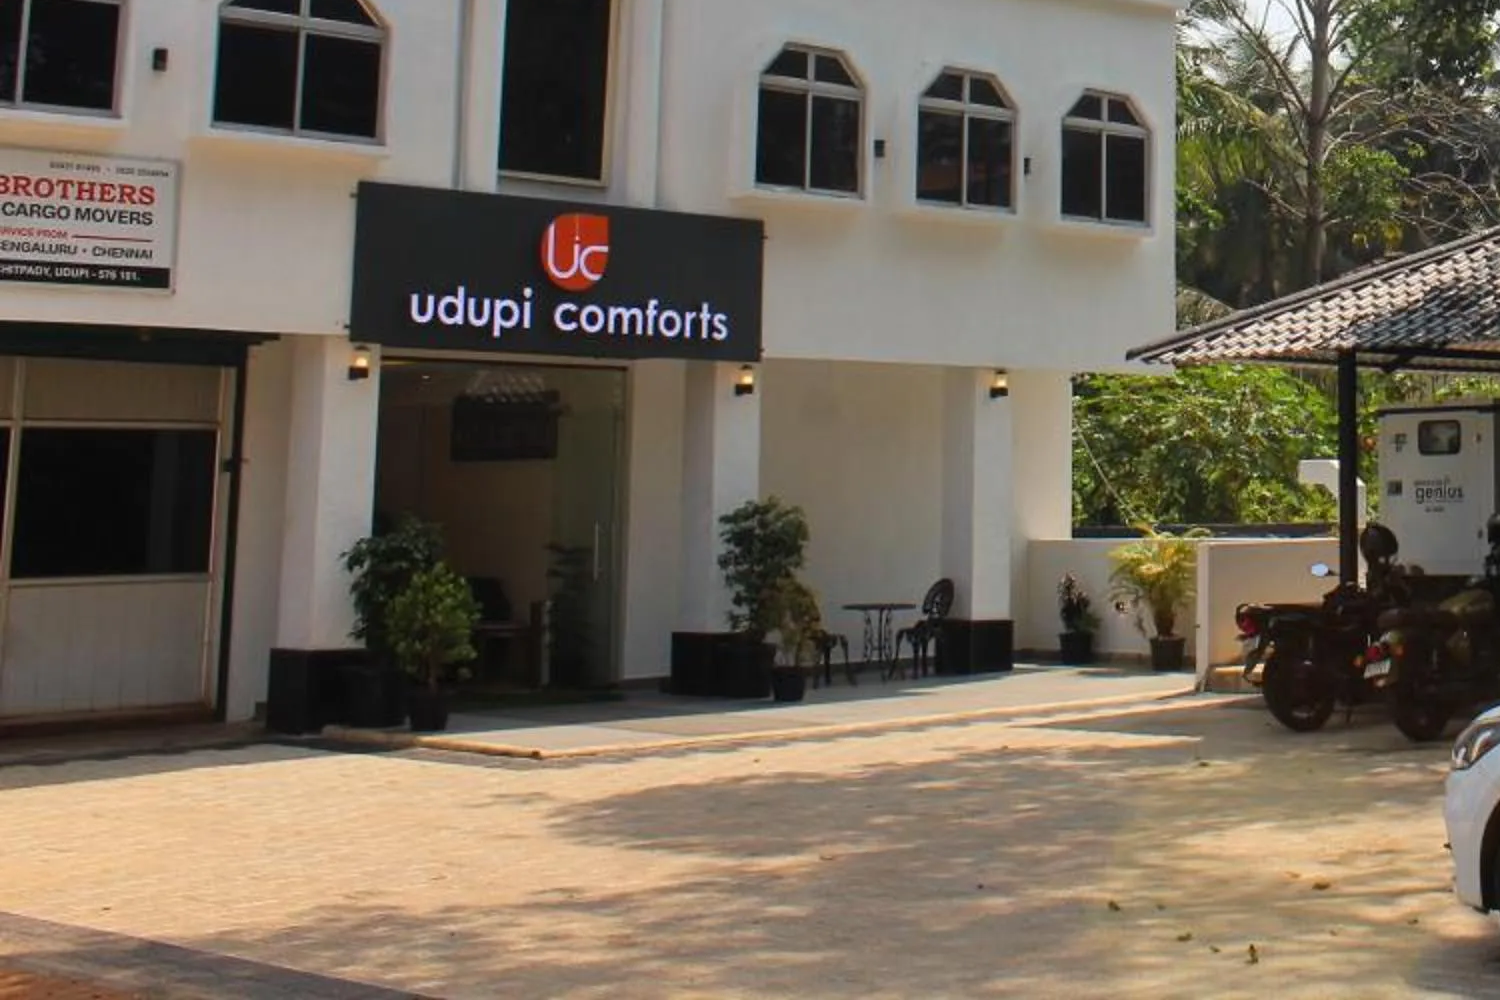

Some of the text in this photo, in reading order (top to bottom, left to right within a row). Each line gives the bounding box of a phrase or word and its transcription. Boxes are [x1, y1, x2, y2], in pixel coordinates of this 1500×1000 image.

[0, 174, 156, 206] BROTHERS
[1, 201, 154, 226] CARGO MOVERS
[0, 240, 153, 259] ENGALURU CHENNAI
[409, 285, 729, 342] udupi comforts
